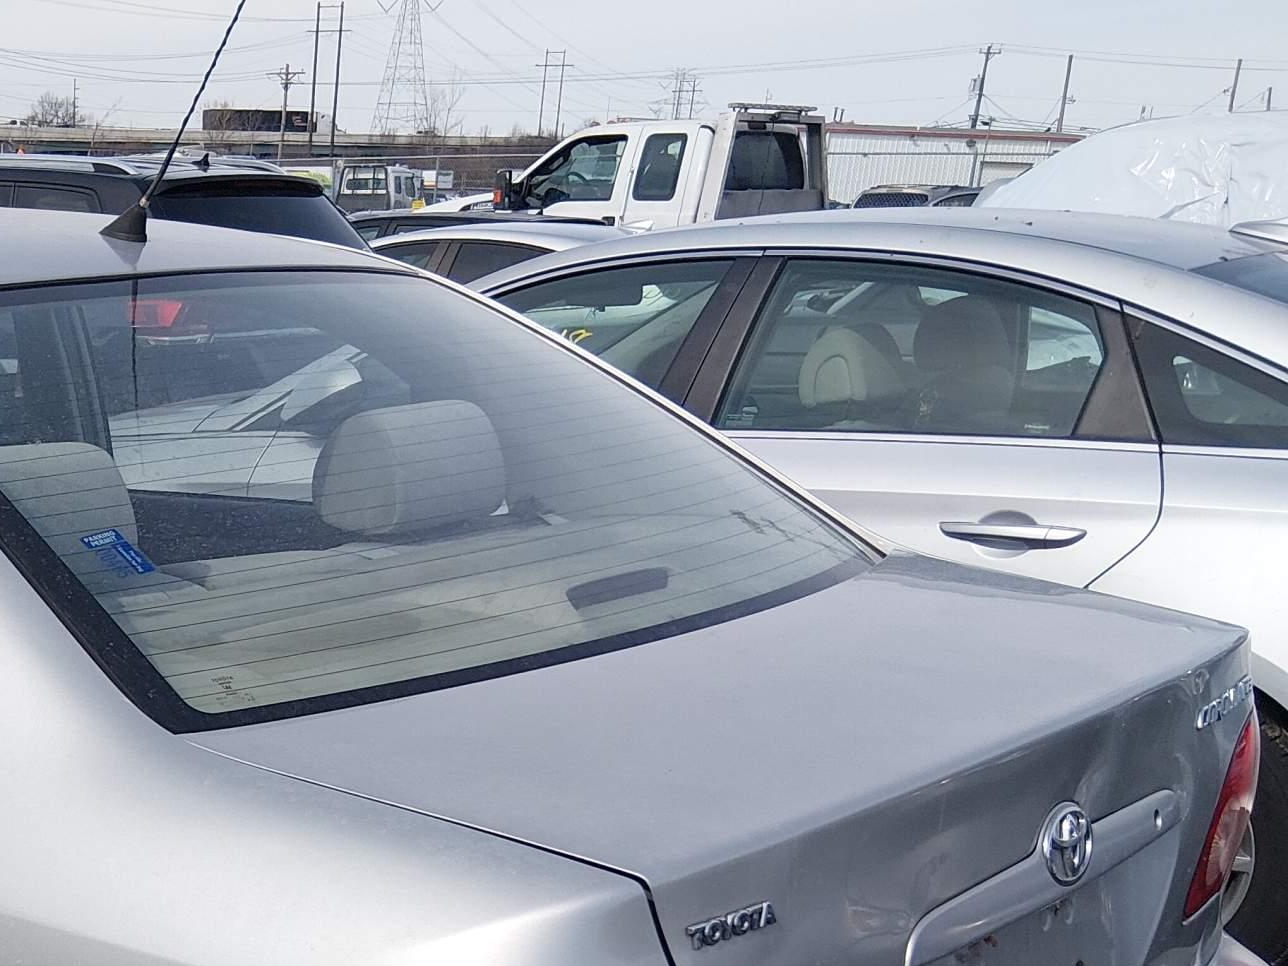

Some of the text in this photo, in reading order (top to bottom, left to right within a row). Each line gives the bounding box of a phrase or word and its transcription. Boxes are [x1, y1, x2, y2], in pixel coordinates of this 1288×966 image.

[83, 530, 116, 543] PARKING
[90, 535, 117, 547] PERMIT
[685, 900, 776, 950] TOYOTA
